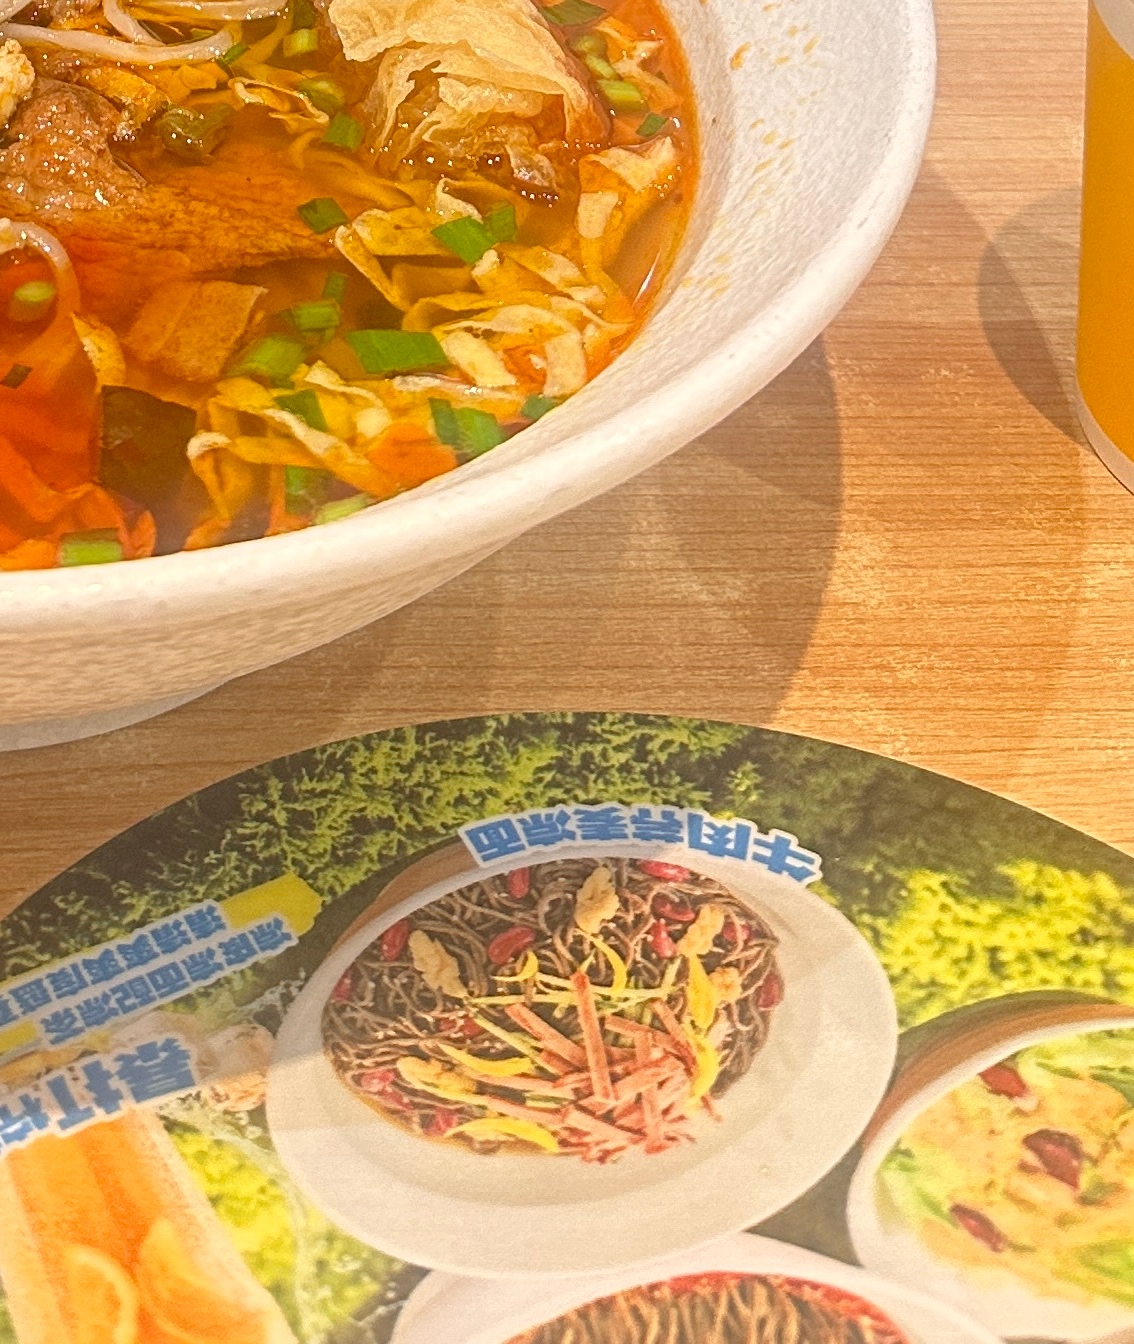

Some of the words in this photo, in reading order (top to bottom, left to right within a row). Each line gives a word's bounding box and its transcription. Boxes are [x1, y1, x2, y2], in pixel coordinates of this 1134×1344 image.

[466, 806, 817, 882] 牛肉荞麦凉面
[40, 916, 293, 1044] 凉皮凉面配凉茶
